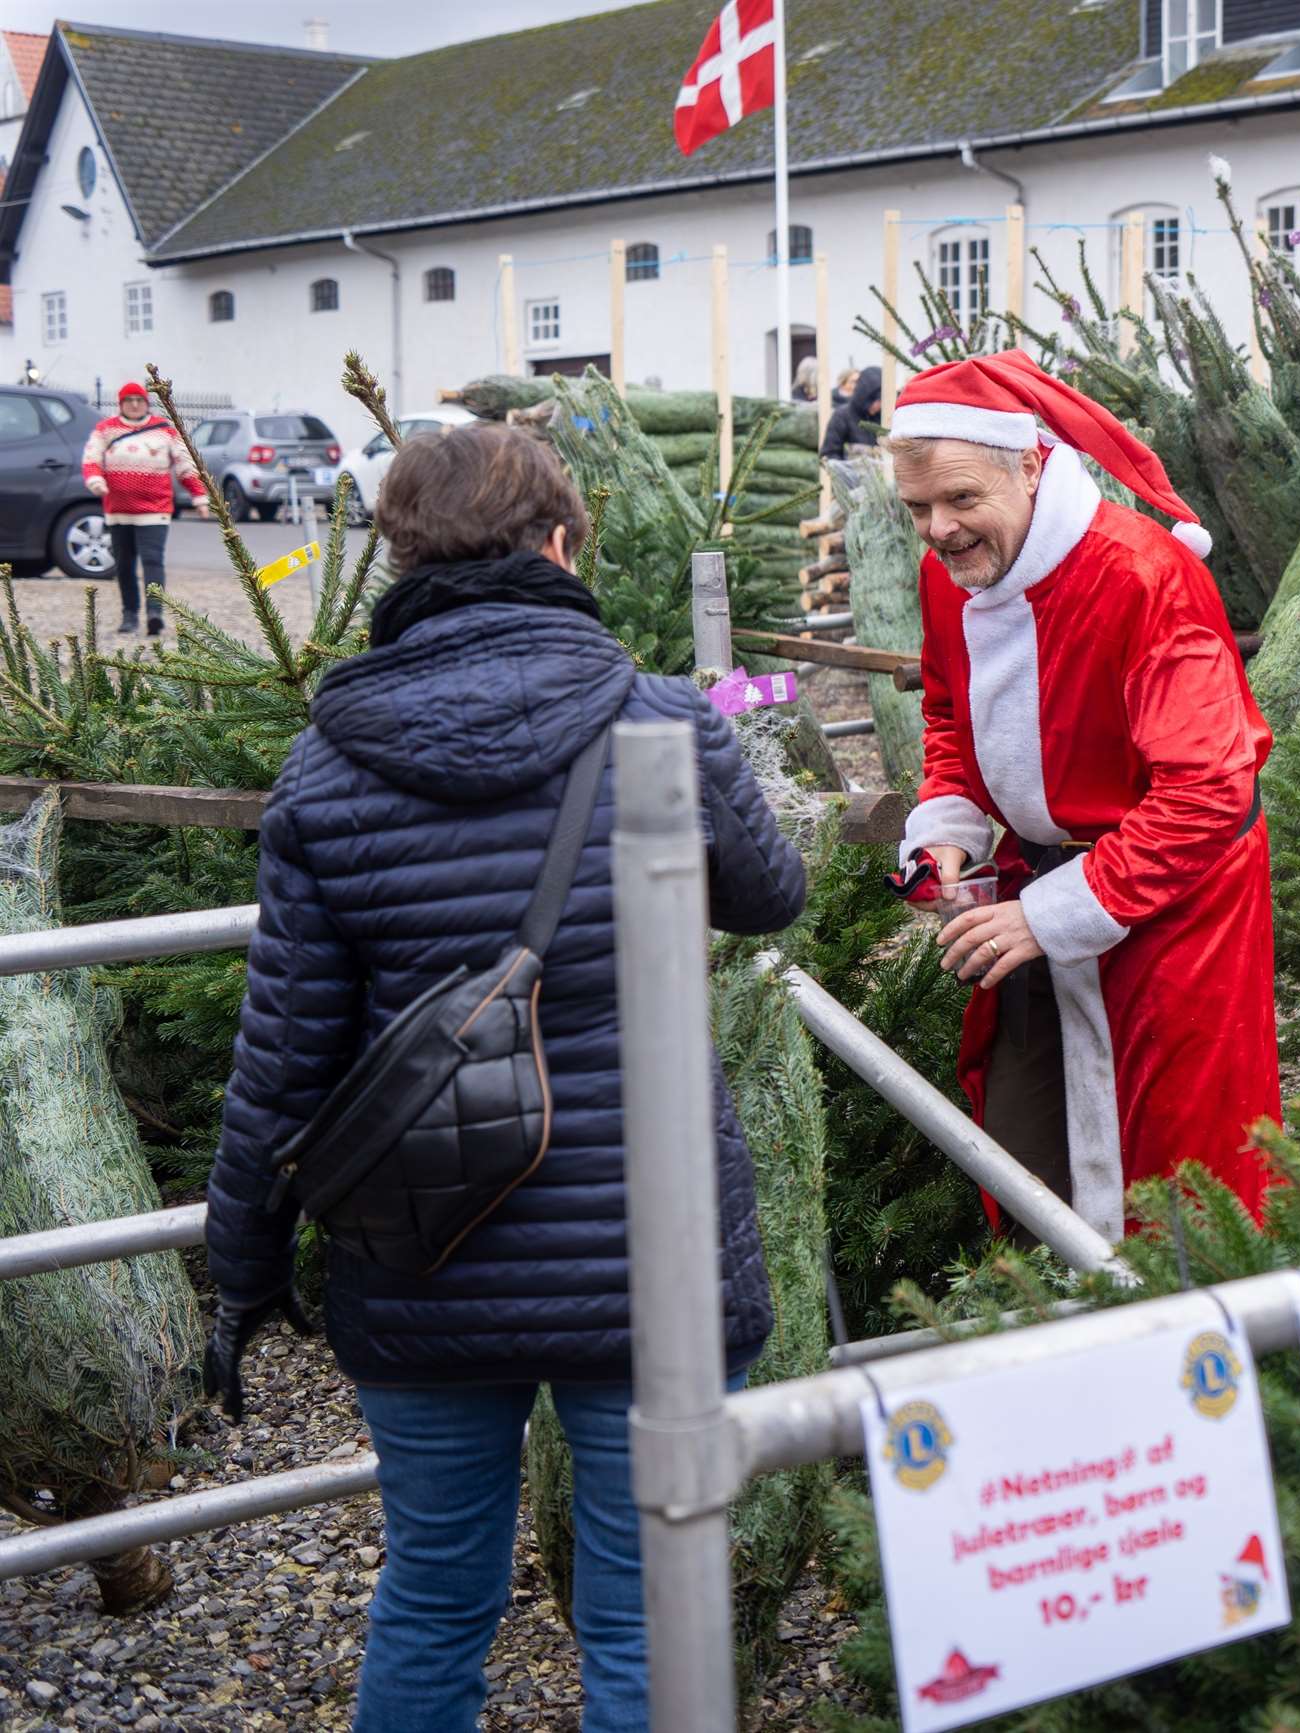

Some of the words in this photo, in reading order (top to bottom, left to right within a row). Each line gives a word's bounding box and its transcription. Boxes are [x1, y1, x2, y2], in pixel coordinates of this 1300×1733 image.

[1147, 1433, 1174, 1464] af
[1103, 1486, 1167, 1518] børn
[1175, 1474, 1207, 1499] og
[1113, 1575, 1148, 1605] kr
